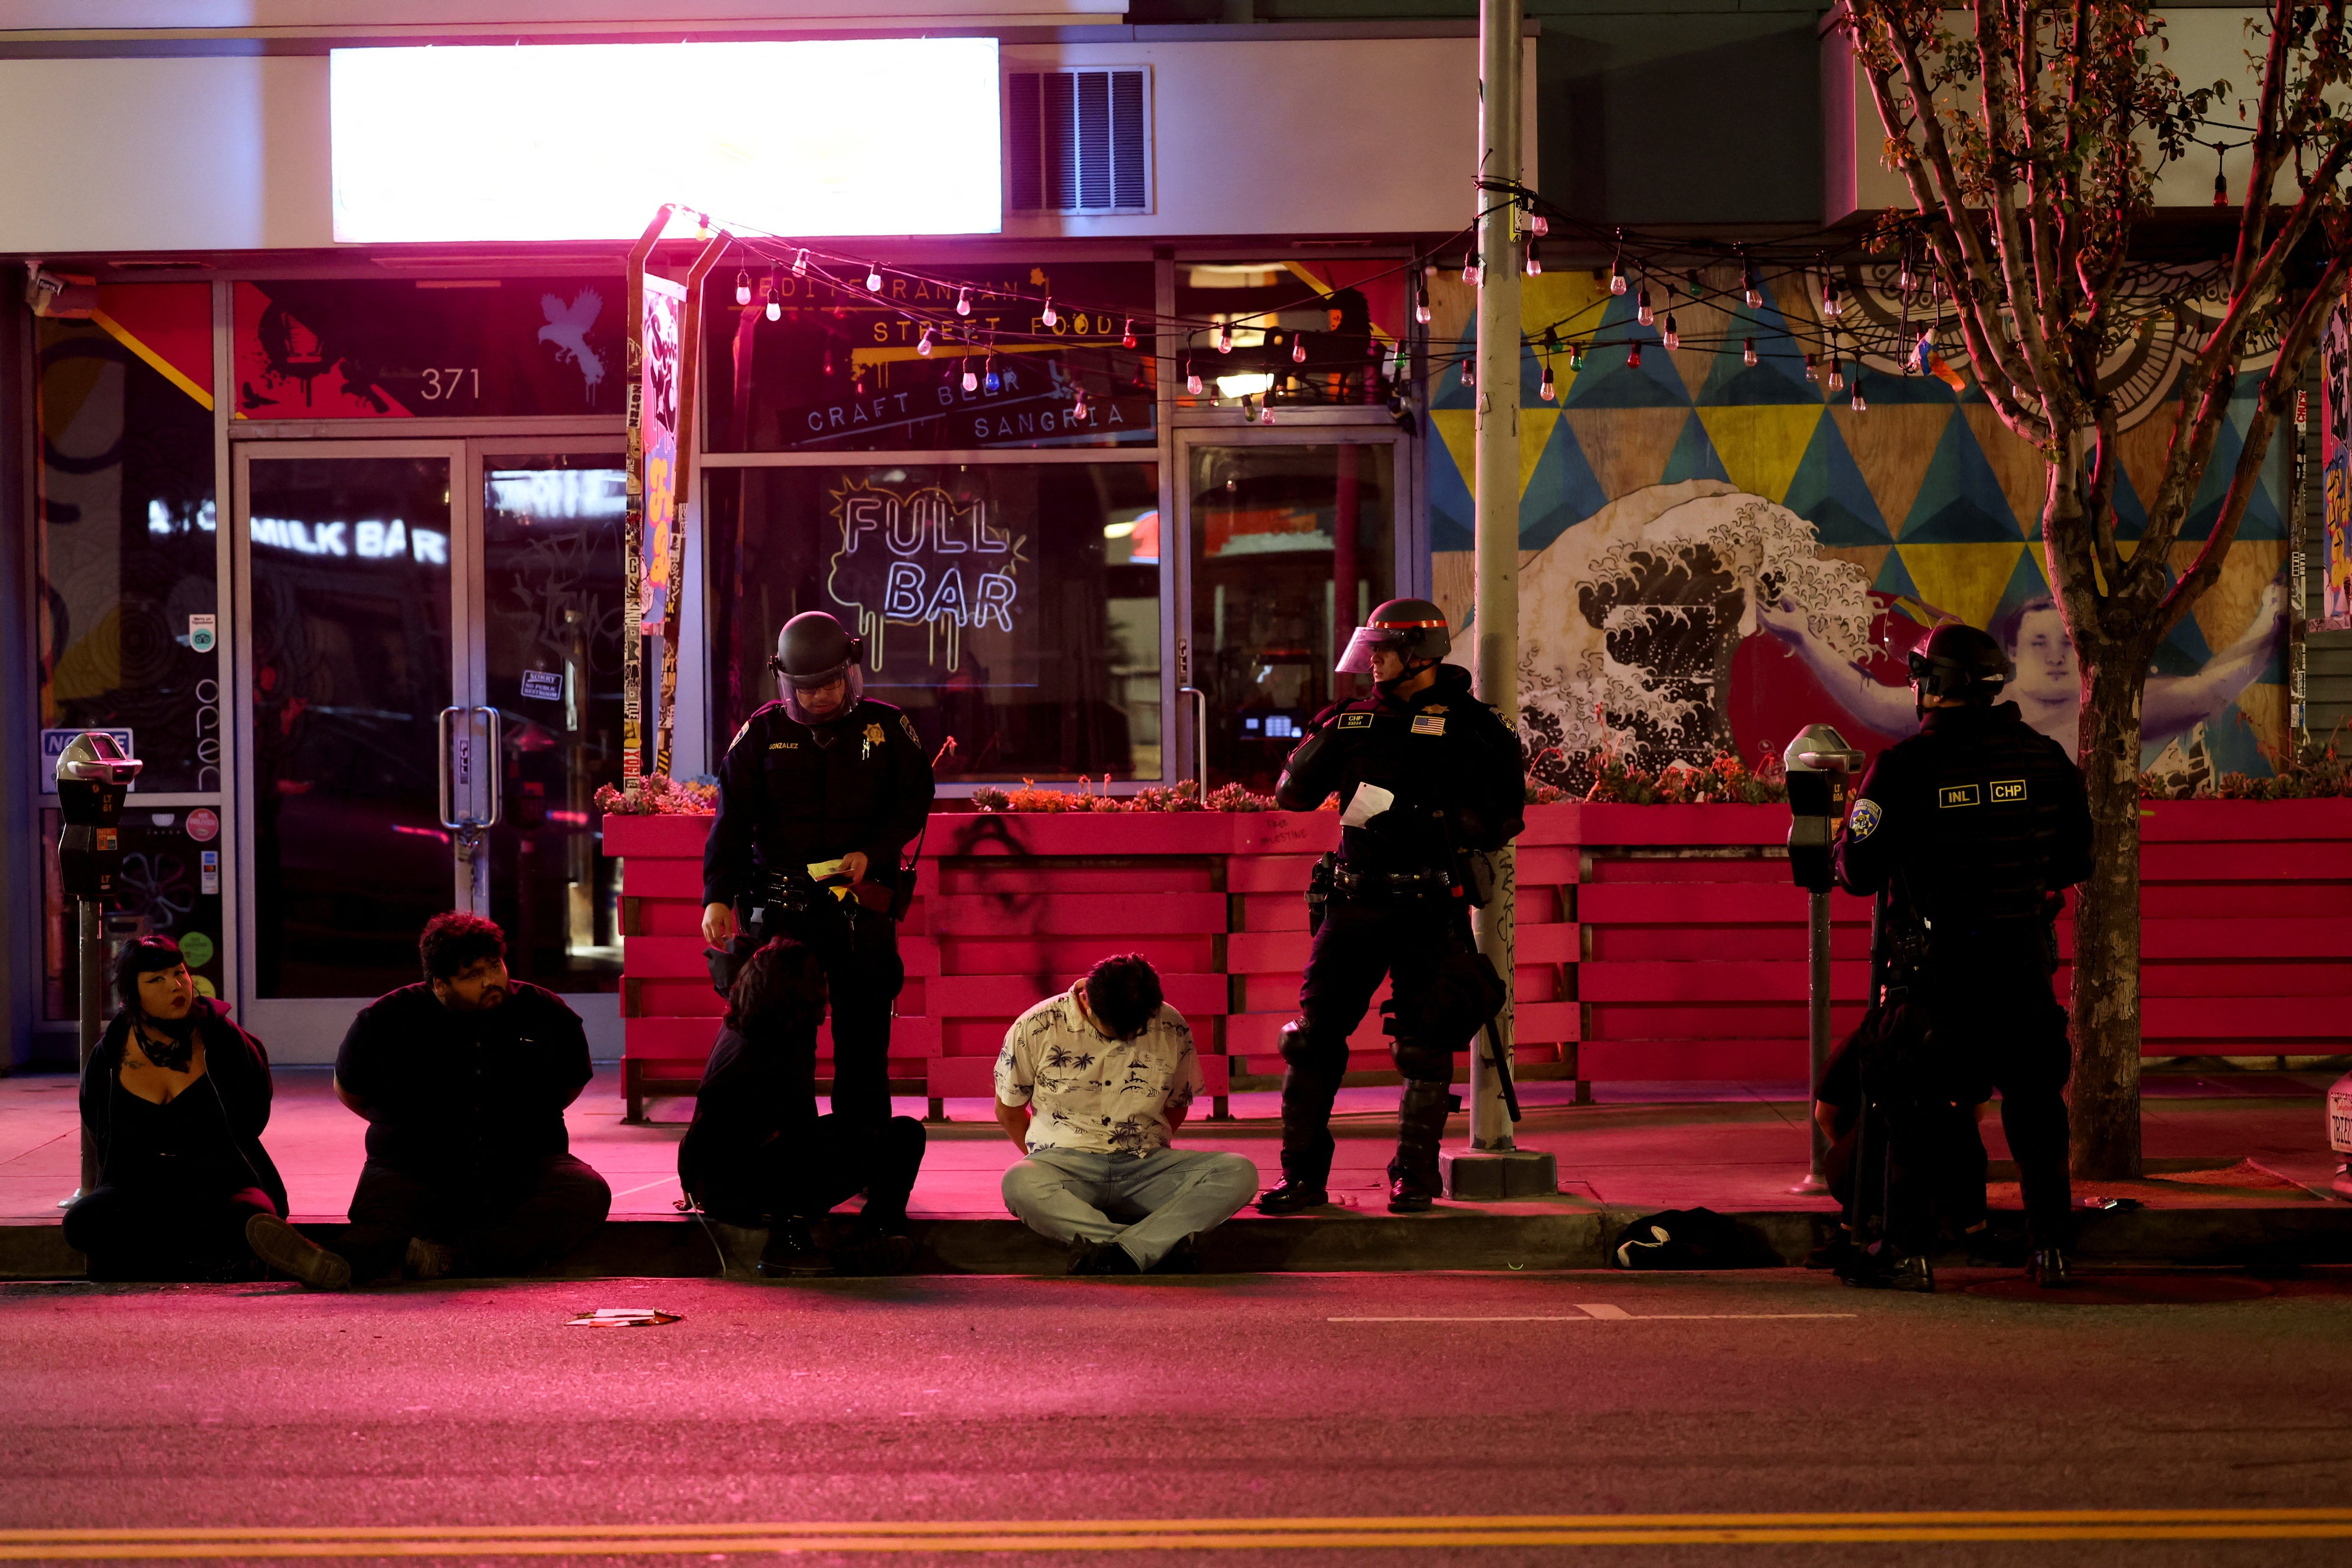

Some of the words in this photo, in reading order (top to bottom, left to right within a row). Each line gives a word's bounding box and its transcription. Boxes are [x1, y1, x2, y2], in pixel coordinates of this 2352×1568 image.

[874, 316, 1001, 342] STREET
[1031, 312, 1112, 335] FOOD
[420, 367, 479, 400] 371
[808, 392, 909, 432] CRAFT
[974, 404, 1124, 438] SANGRIA
[2296, 391, 2308, 423] CHUCK
[250, 516, 348, 557] MILK
[355, 518, 447, 565] BAR
[845, 497, 1009, 557] FULL
[884, 561, 1018, 633] BAR
[103, 794, 113, 803] LT
[1834, 784, 1841, 793] LT
[1948, 790, 1971, 803] INL
[1995, 785, 2022, 798] CHP
[101, 875, 111, 884] LT
